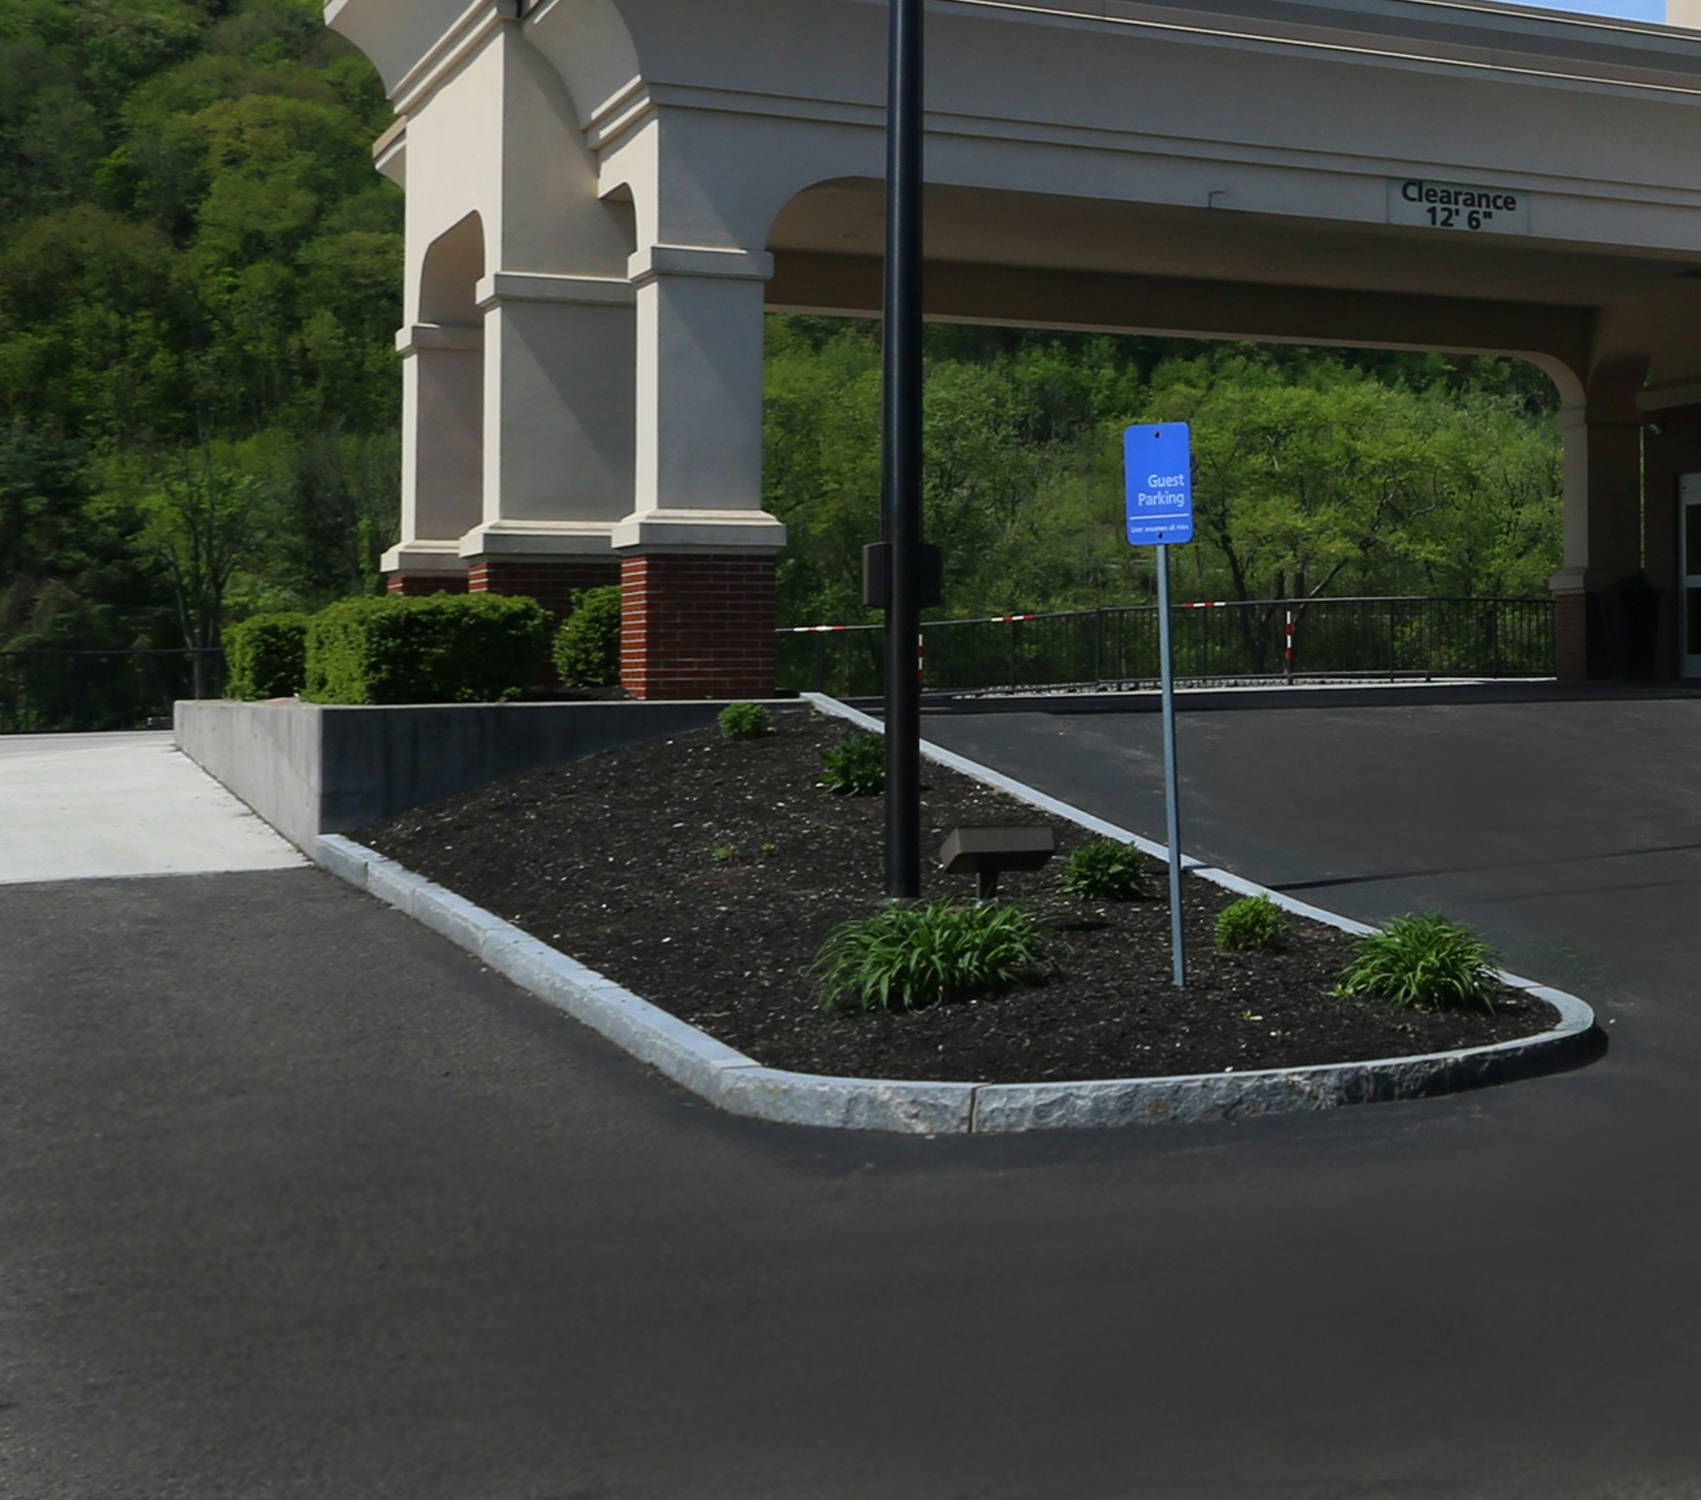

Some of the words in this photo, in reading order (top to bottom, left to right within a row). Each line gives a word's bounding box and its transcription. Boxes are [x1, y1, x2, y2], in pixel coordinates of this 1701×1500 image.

[1401, 180, 1517, 211] Clearance
[1426, 206, 1460, 228] 12'
[1467, 210, 1493, 230] 6"
[1148, 473, 1185, 488] Guest
[1138, 491, 1185, 507] Parking
